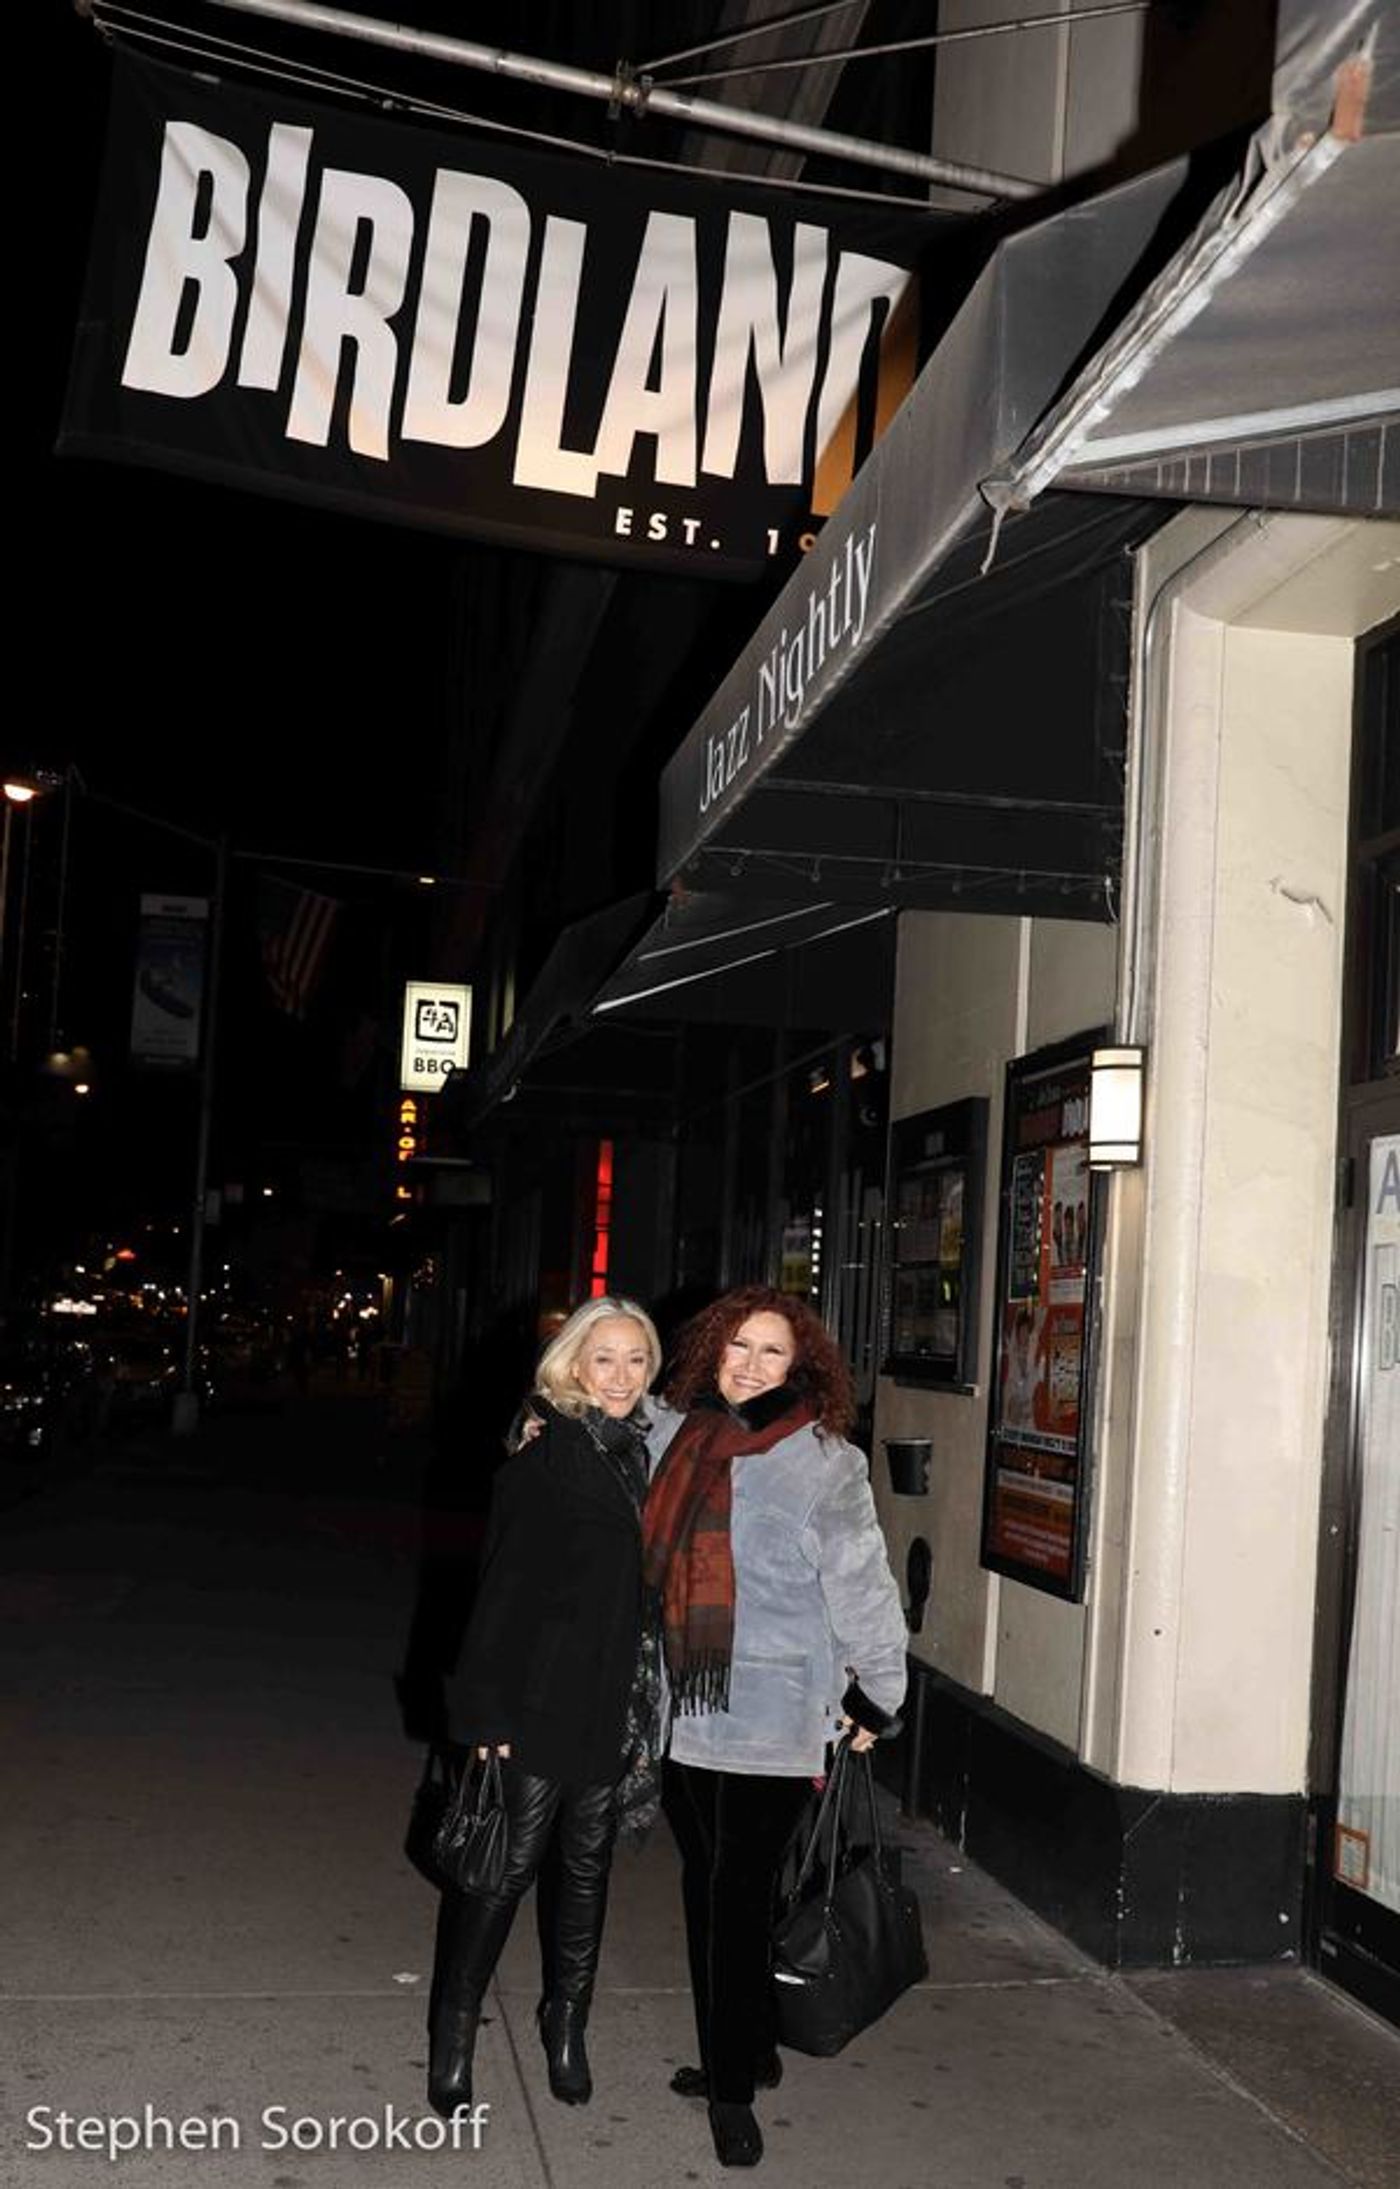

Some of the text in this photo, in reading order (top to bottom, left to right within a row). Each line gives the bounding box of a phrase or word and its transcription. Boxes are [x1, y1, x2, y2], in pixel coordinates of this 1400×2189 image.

[614, 506, 721, 550] EST.
[700, 523, 877, 813] Jazz Nightly
[1375, 1150, 1400, 1214] A
